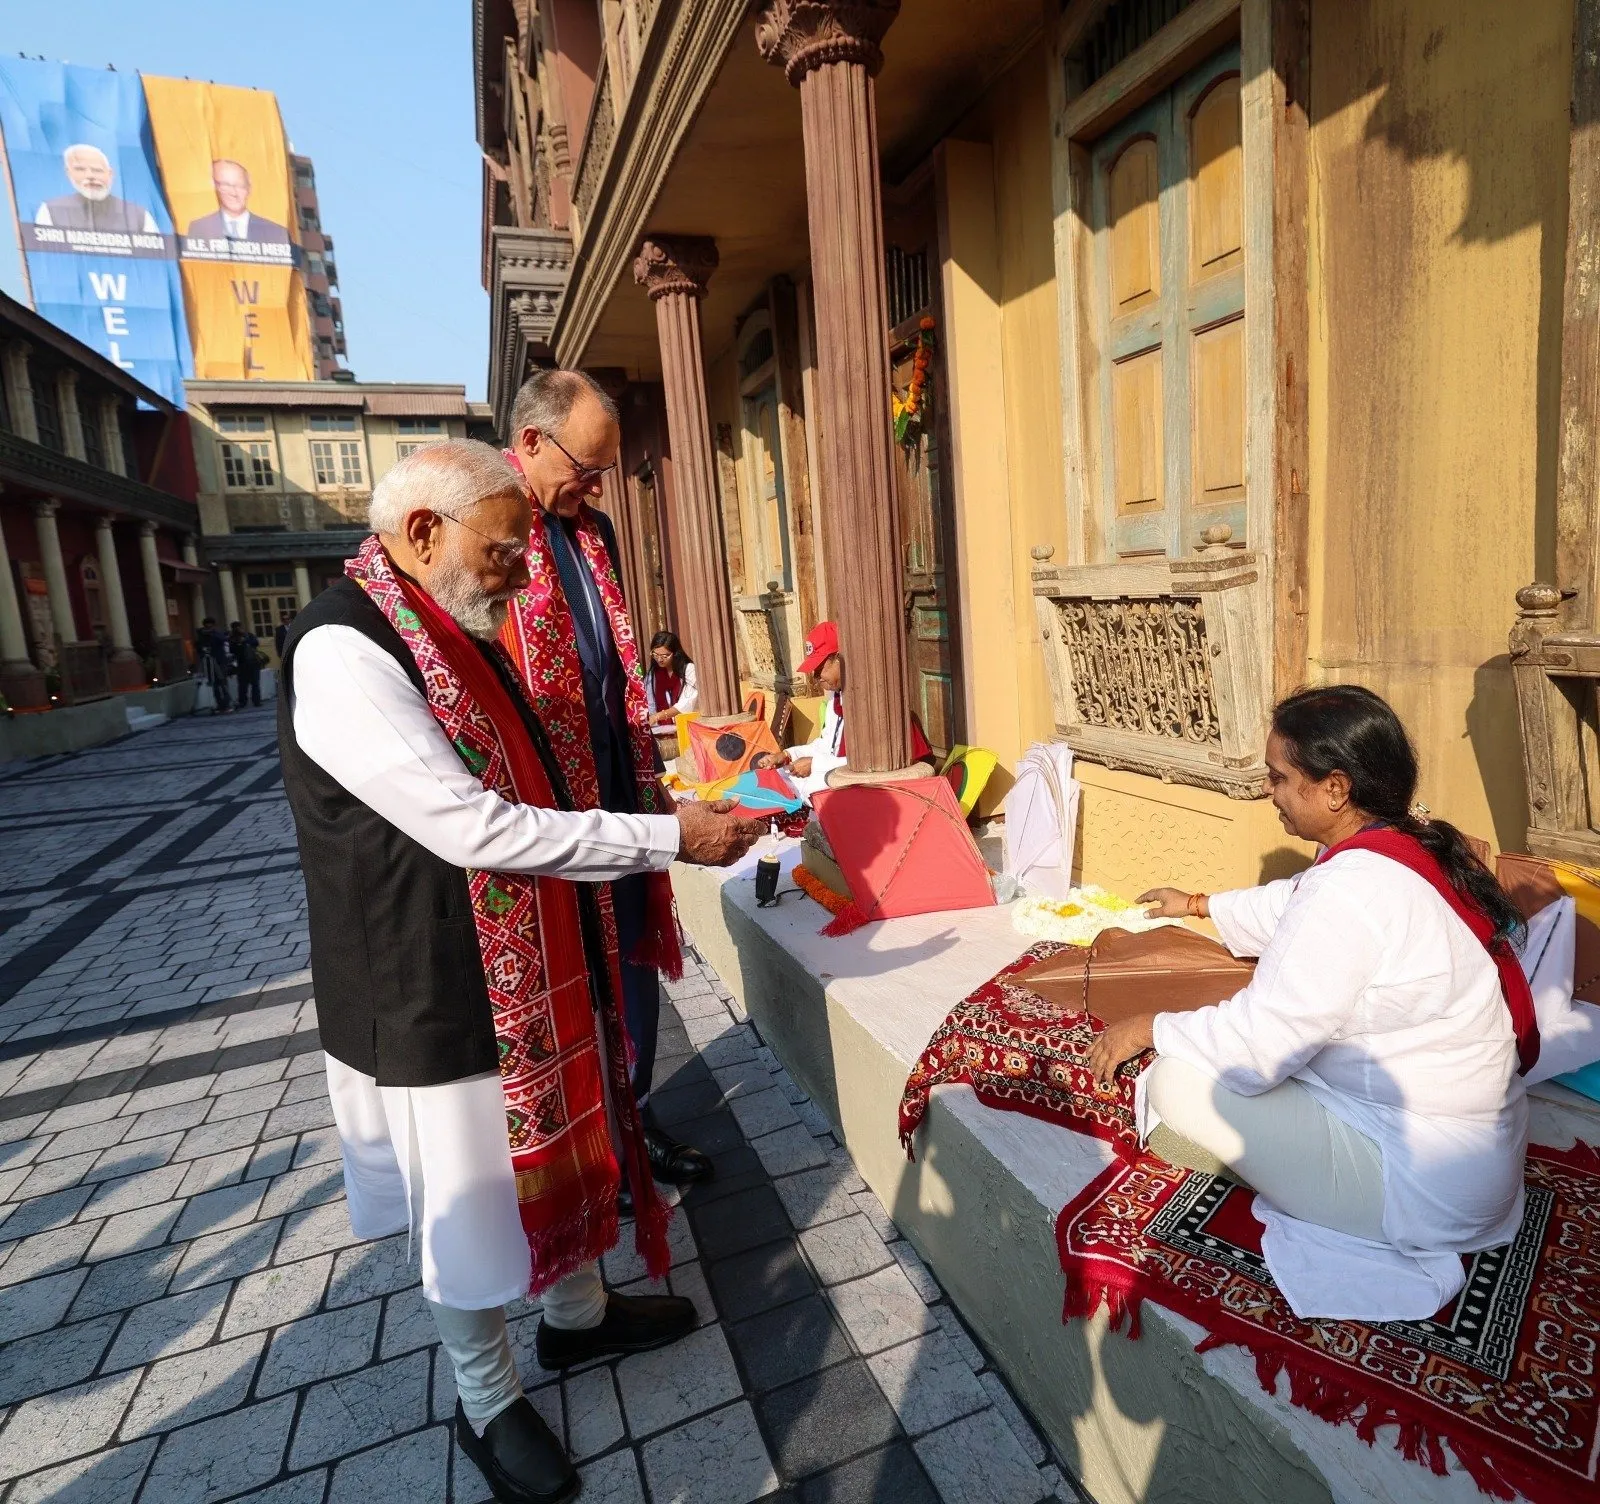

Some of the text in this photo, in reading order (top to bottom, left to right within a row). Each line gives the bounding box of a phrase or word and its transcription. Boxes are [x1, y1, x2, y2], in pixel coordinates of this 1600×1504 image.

[34, 227, 66, 243] SHRI
[66, 230, 132, 248] NARENDRA
[209, 239, 261, 256] FRIDRICH
[89, 272, 135, 369] WEL
[231, 279, 264, 382] WEL
